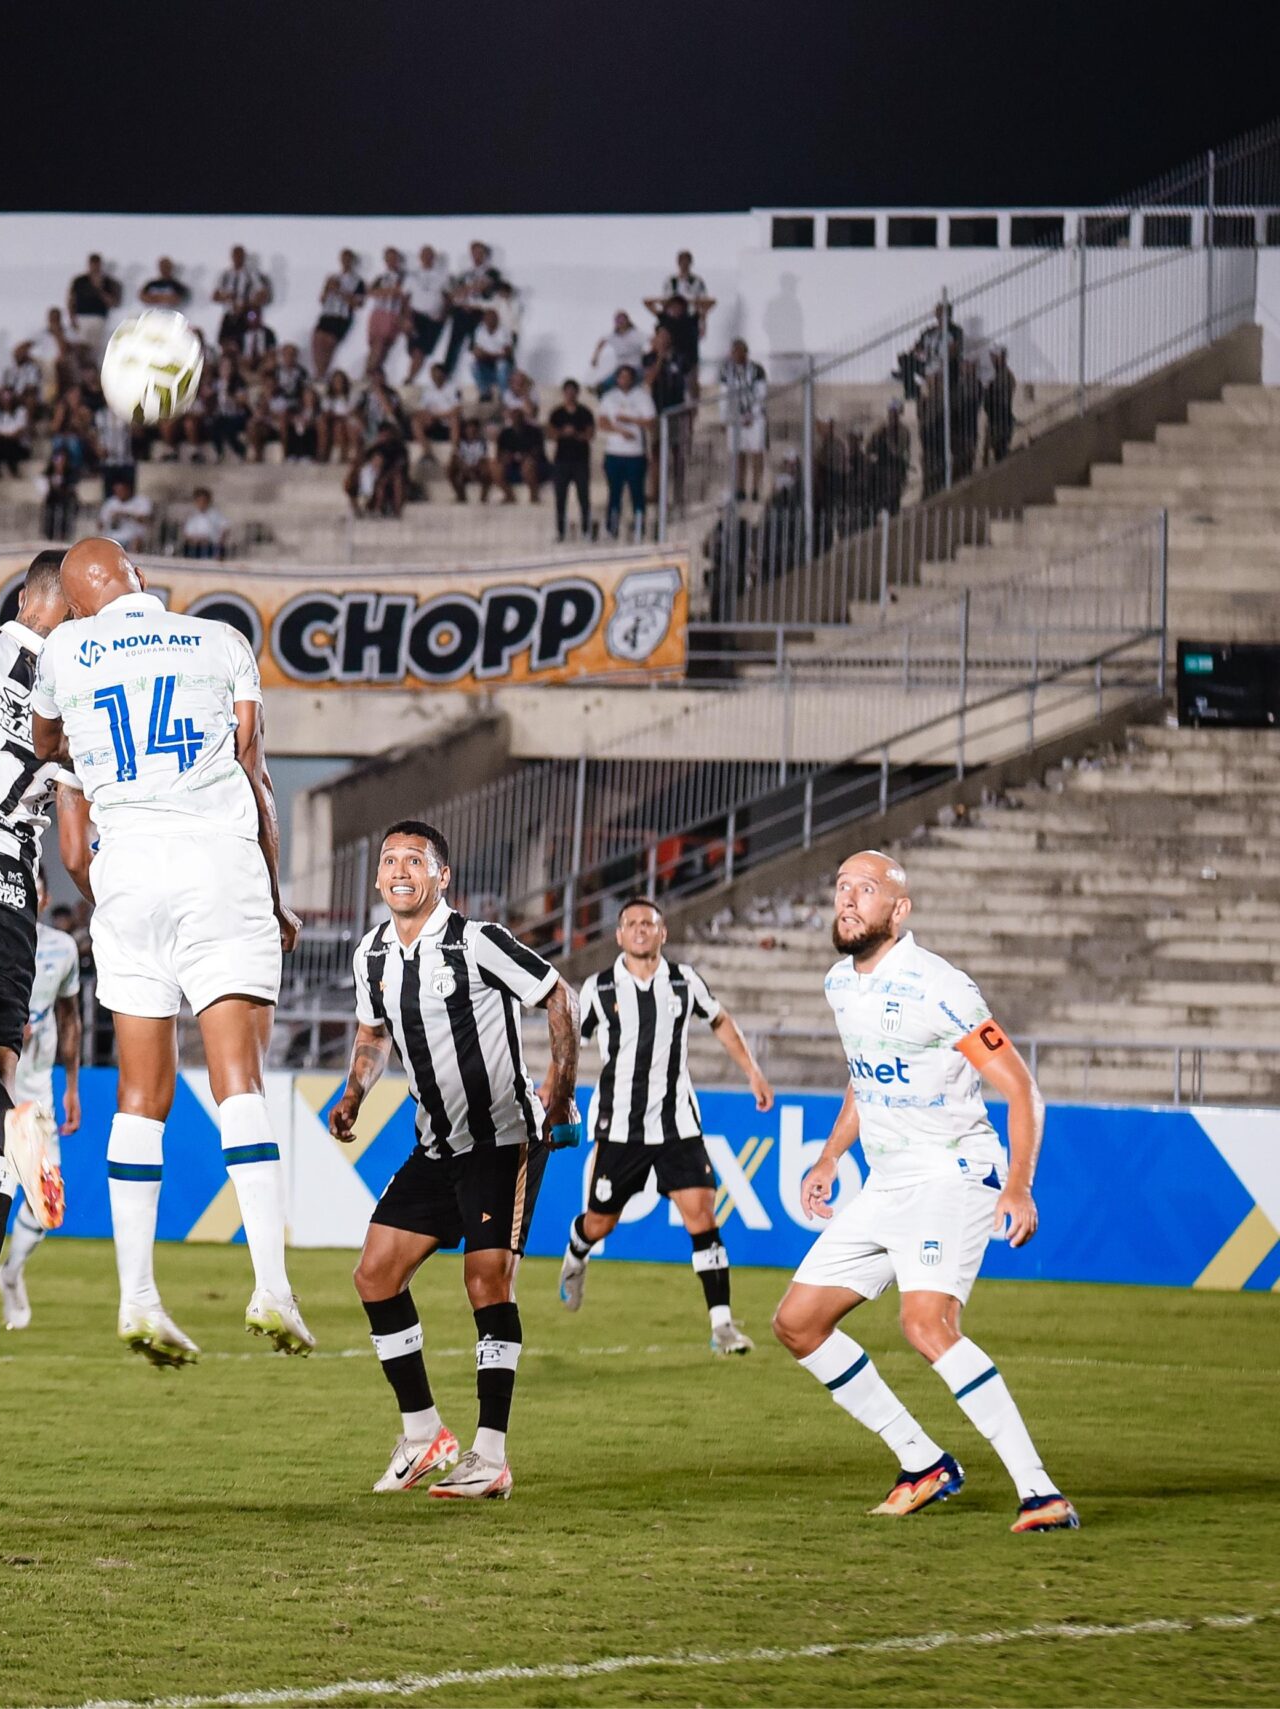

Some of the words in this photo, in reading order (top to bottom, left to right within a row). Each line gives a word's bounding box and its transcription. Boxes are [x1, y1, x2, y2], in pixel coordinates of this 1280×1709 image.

[274, 577, 602, 682] CHOPP
[113, 635, 162, 651] NOVA
[168, 635, 202, 646] ART
[125, 647, 195, 657] EQUIPAMENTOS
[94, 675, 205, 782] 14
[15, 886, 27, 897] DO
[979, 1025, 1005, 1051] C
